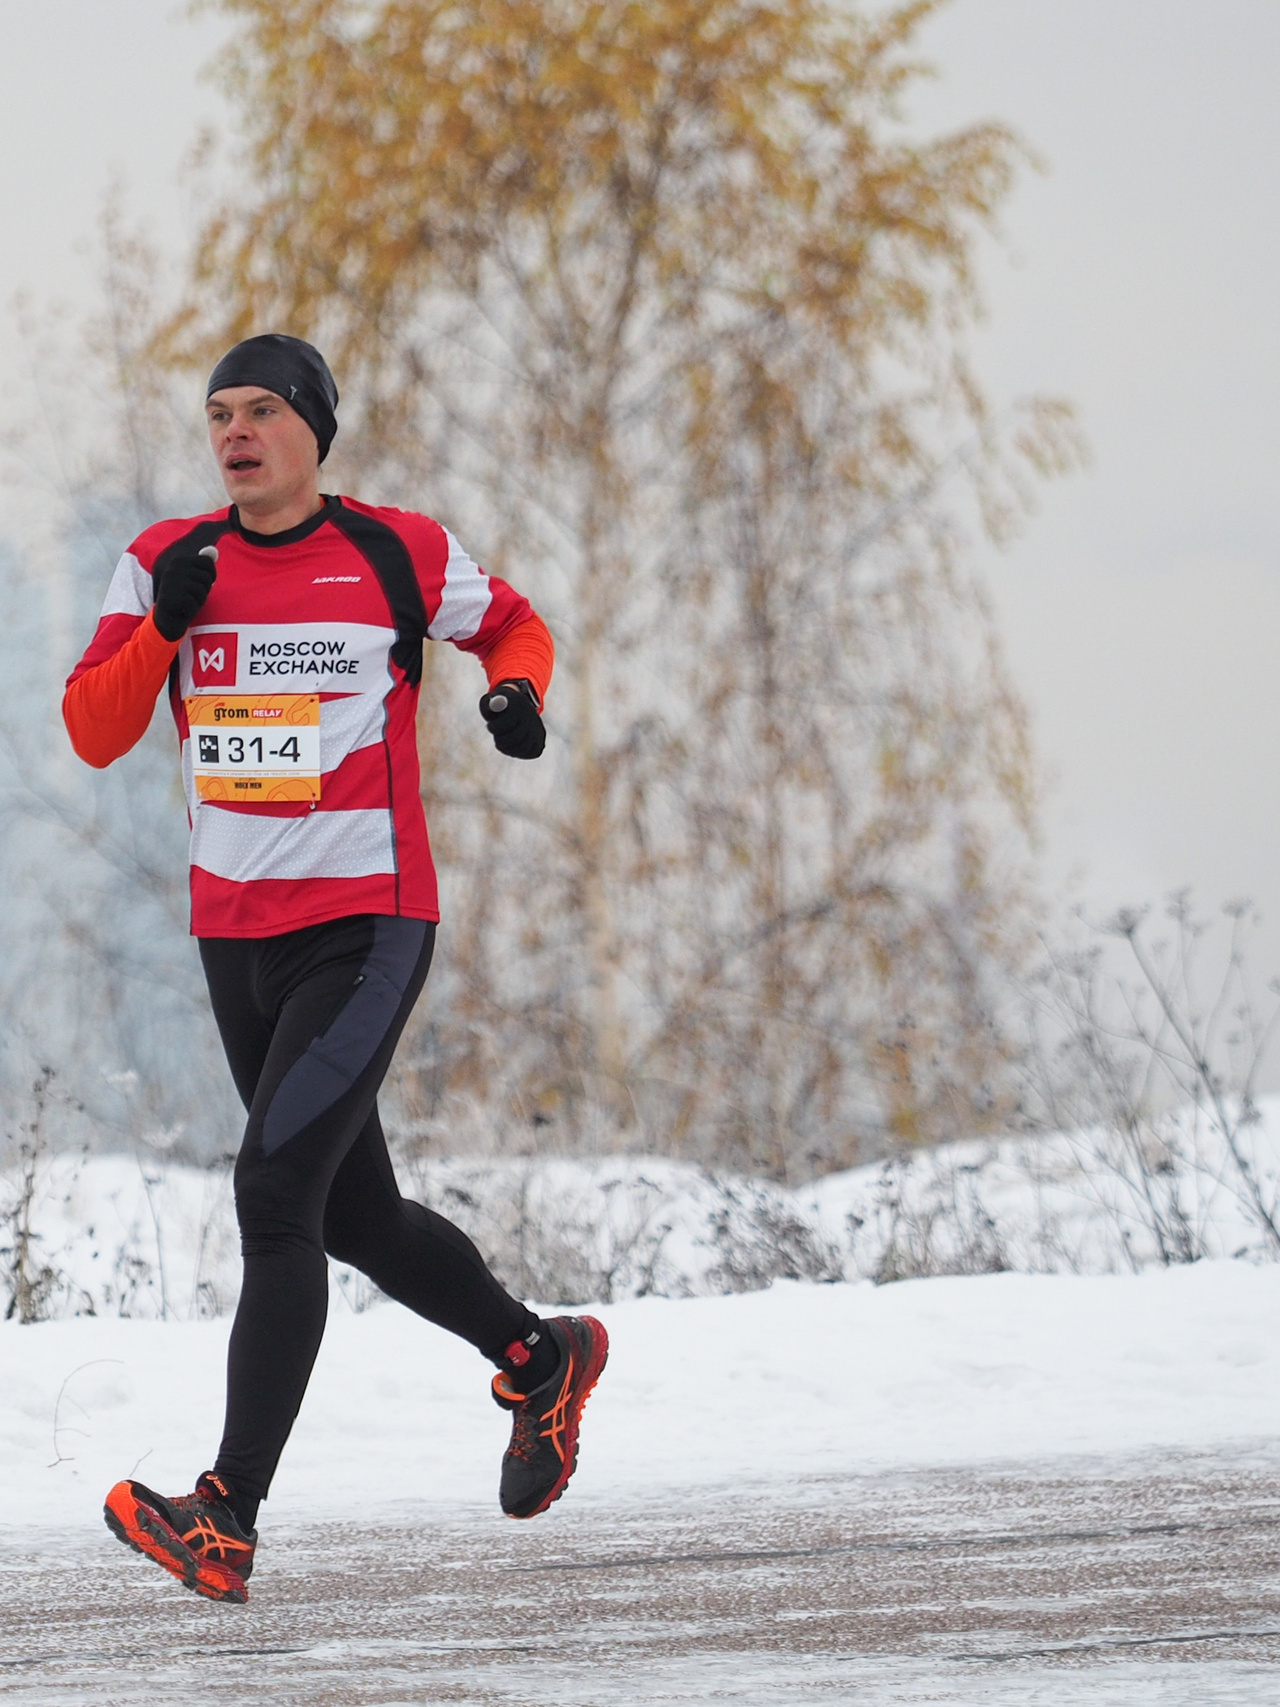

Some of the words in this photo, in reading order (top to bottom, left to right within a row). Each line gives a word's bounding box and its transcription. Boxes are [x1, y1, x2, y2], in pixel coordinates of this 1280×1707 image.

[250, 641, 345, 657] MOSCOW
[249, 660, 359, 675] EXCHANGE
[214, 703, 249, 721] grom
[253, 709, 282, 717] RELAY
[228, 736, 301, 763] 31-4
